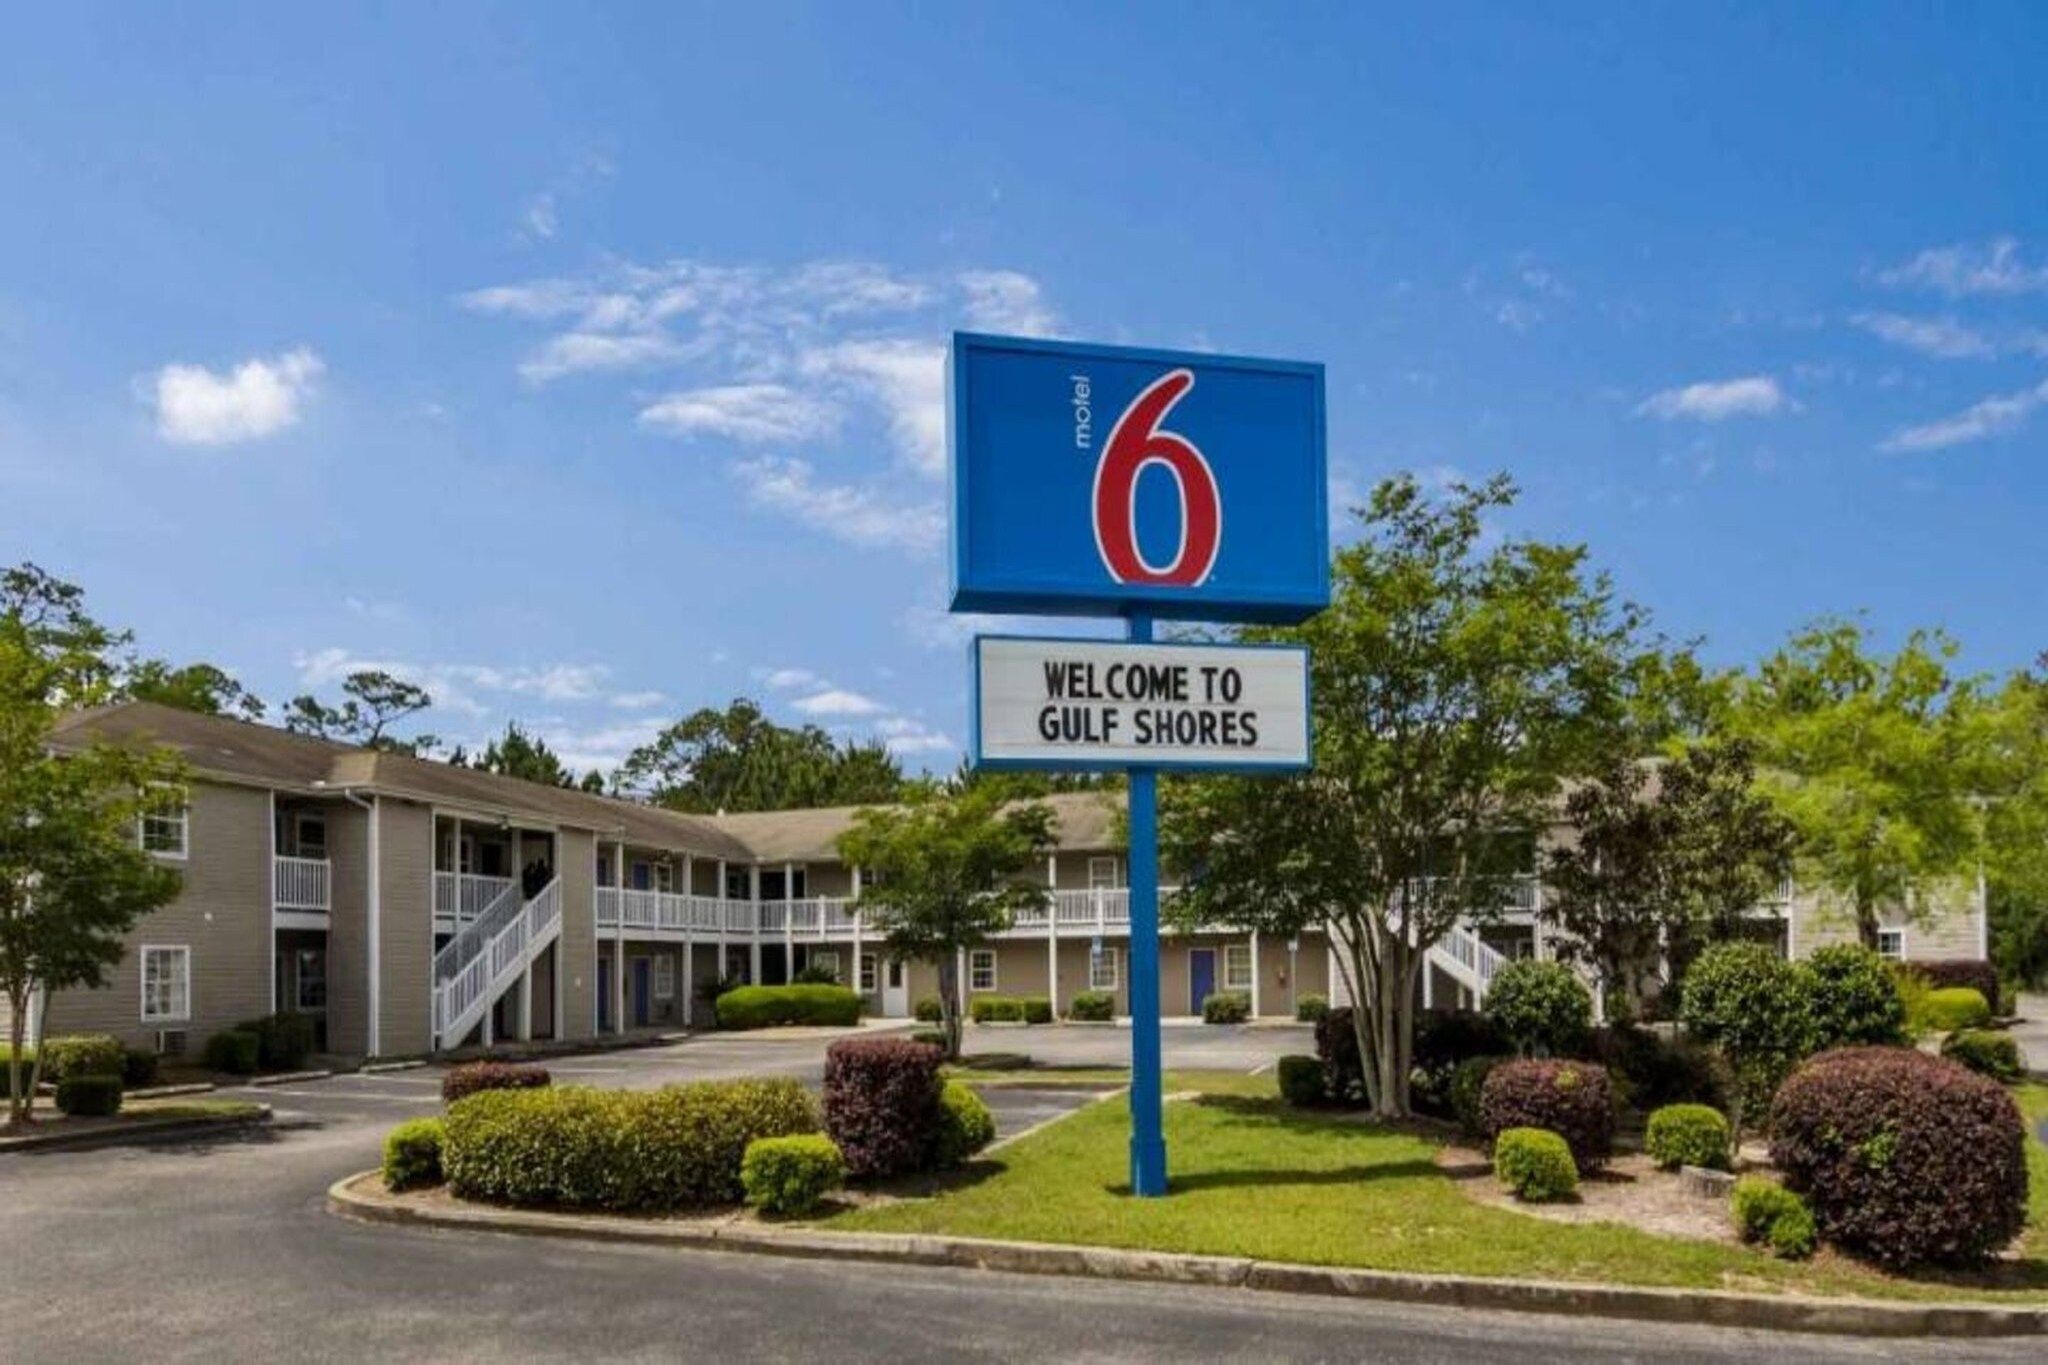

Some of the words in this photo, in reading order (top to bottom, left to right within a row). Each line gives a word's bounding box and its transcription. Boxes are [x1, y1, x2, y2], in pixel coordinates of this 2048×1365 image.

[1072, 375, 1091, 449] motel
[1092, 368, 1222, 587] 6
[1044, 661, 1188, 702] WELCOME
[1200, 667, 1242, 703] TO
[1038, 705, 1119, 743] GULF
[1134, 709, 1258, 747] SHORES
